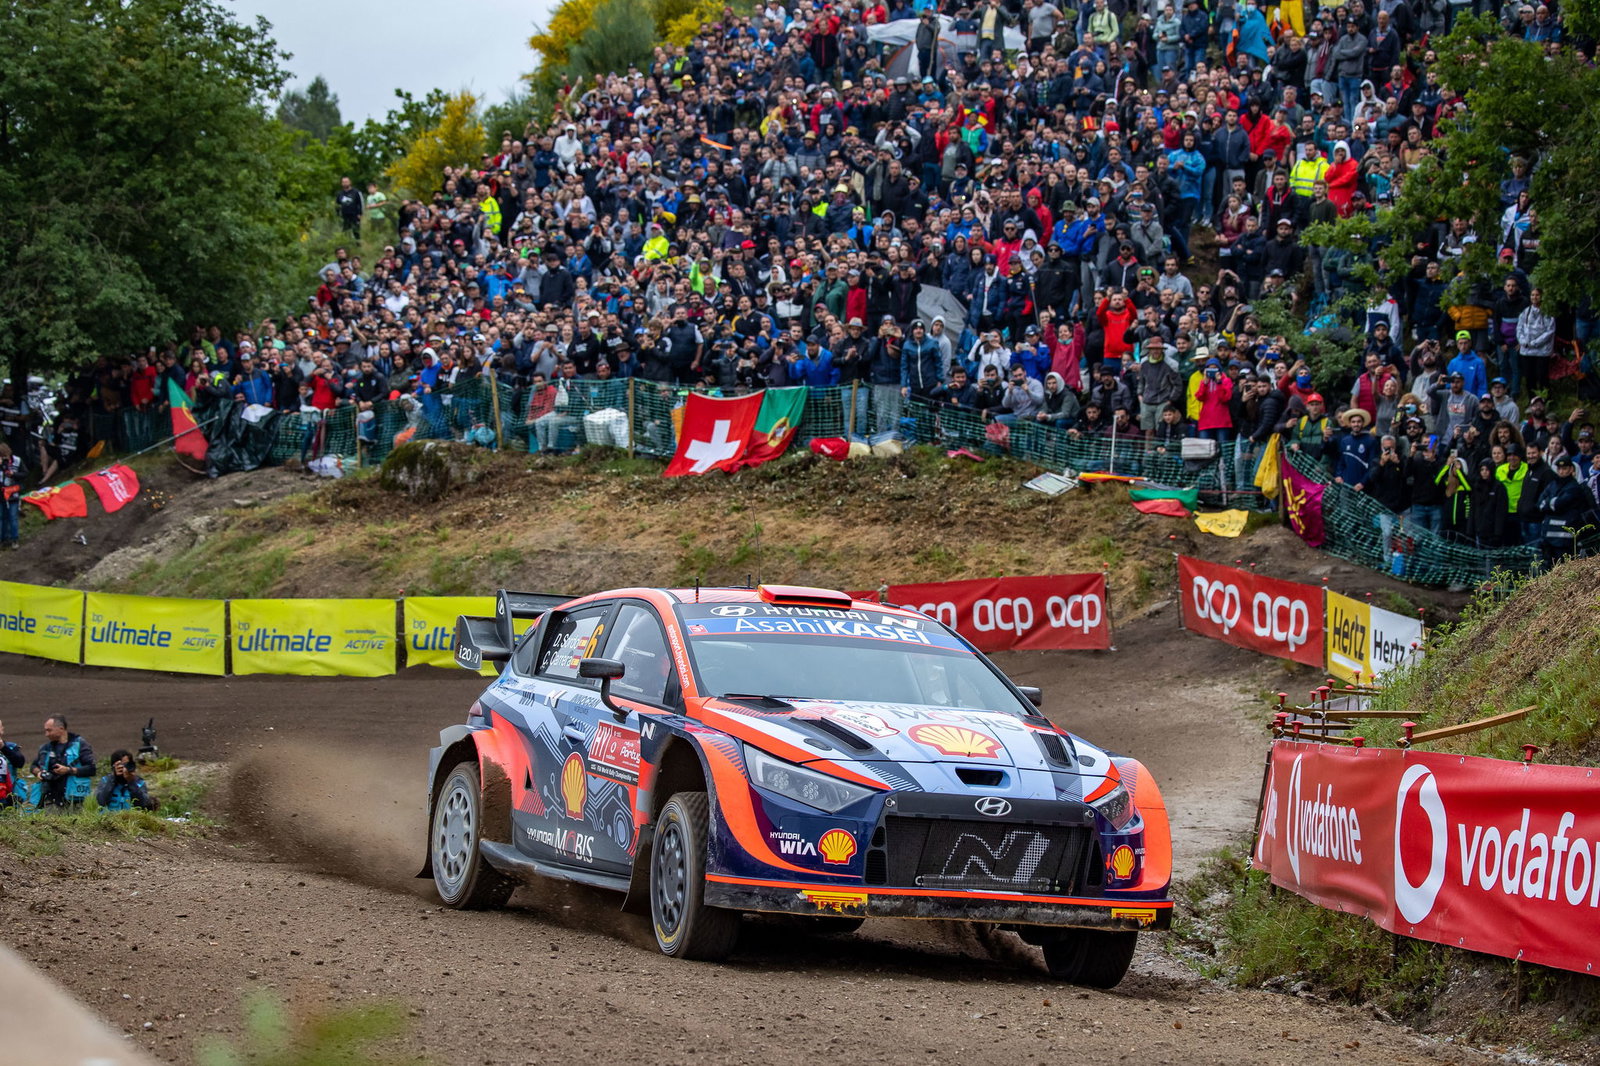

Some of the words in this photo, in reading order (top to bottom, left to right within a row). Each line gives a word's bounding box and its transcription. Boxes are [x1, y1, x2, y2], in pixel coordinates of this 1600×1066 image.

[238, 620, 250, 631] bp
[413, 619, 427, 630] bp
[762, 606, 870, 622] HYUNDAI
[901, 601, 958, 631] cp
[972, 597, 1034, 637] acp
[1046, 593, 1101, 635] acp
[1193, 575, 1242, 635] acp
[1253, 592, 1309, 652] acp
[46, 624, 76, 636] ACTIVE
[91, 620, 172, 647] ultimate
[238, 628, 332, 652] ultimate
[412, 627, 457, 651] ulti
[583, 623, 606, 658] 6
[1333, 607, 1366, 661] Hertz
[182, 637, 217, 648] ACTIVE
[344, 640, 386, 650] ACTIVE
[1373, 629, 1406, 665] Hertz
[889, 709, 1025, 732] MOBIS
[769, 831, 801, 840] HYUNDAI
[1301, 783, 1362, 865] vodafone
[554, 827, 595, 864] MOBIS
[780, 838, 818, 856] WIA
